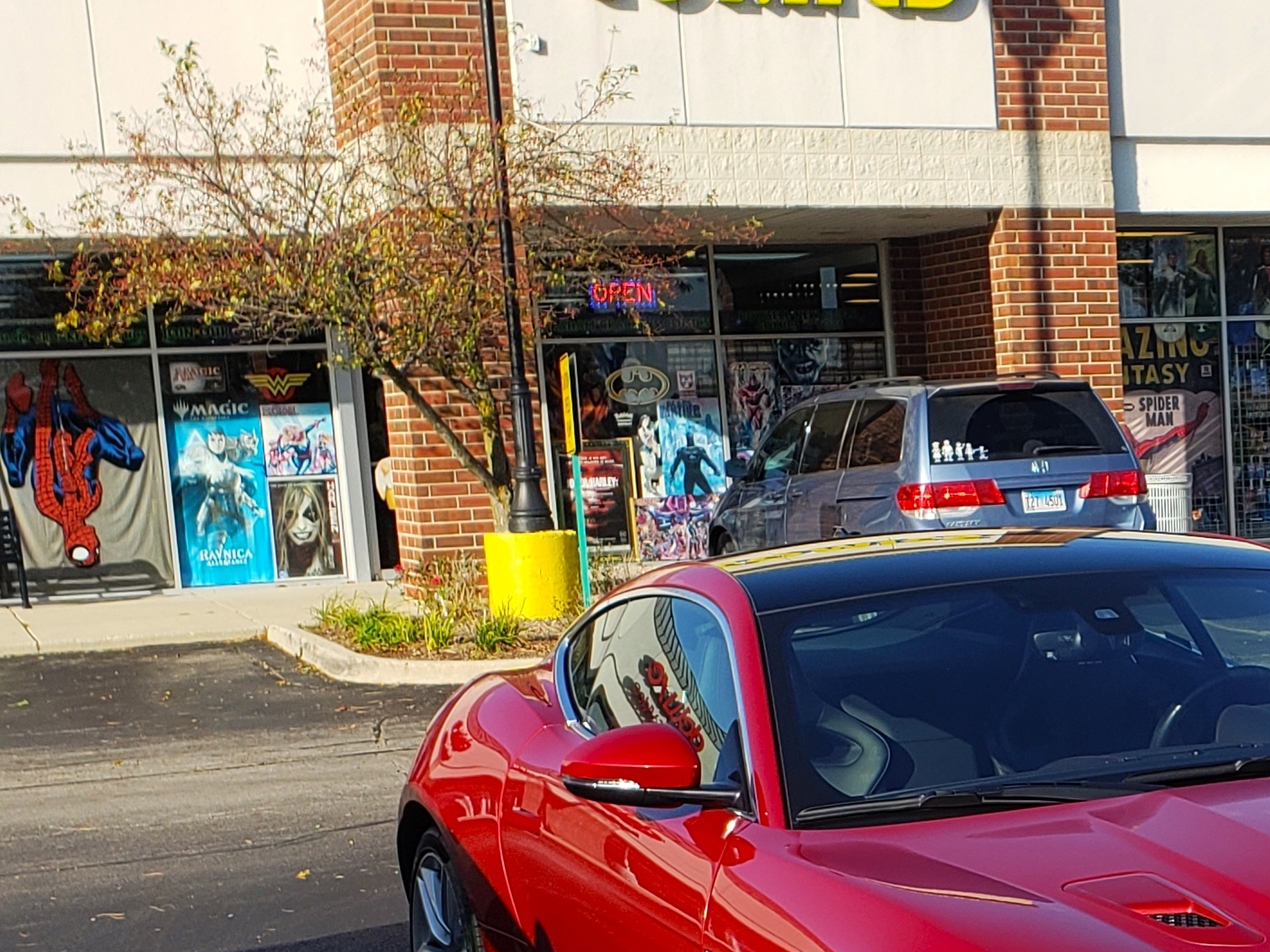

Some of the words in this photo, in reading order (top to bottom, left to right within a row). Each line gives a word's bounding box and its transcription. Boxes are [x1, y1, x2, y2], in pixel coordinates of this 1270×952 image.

[592, 281, 653, 304] OPEN
[190, 400, 250, 417] MAGIC
[1138, 395, 1180, 412] SPIDER
[1145, 410, 1174, 427] MAN
[199, 547, 253, 562] RAVNICA
